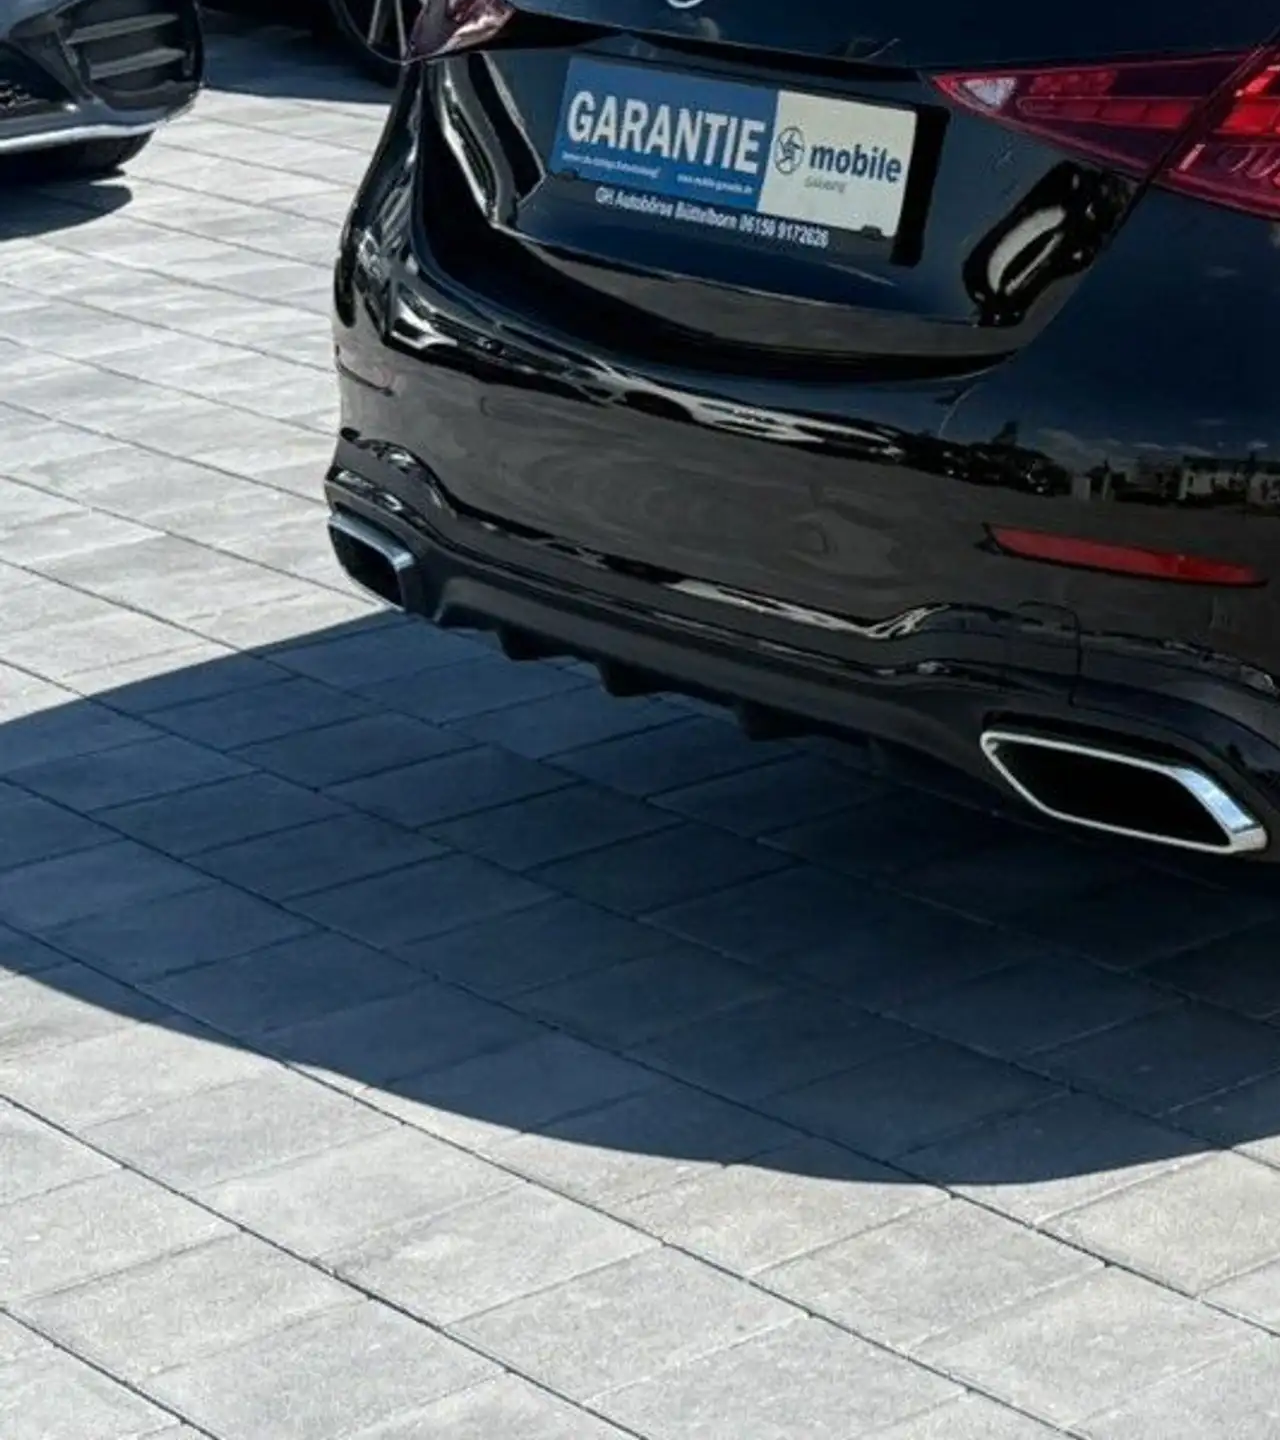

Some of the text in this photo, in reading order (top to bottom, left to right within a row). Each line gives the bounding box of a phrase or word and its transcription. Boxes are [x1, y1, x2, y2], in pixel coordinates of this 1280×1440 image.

[567, 90, 766, 174] GARANTIE
[809, 143, 902, 184] mobile
[594, 185, 614, 206] GH
